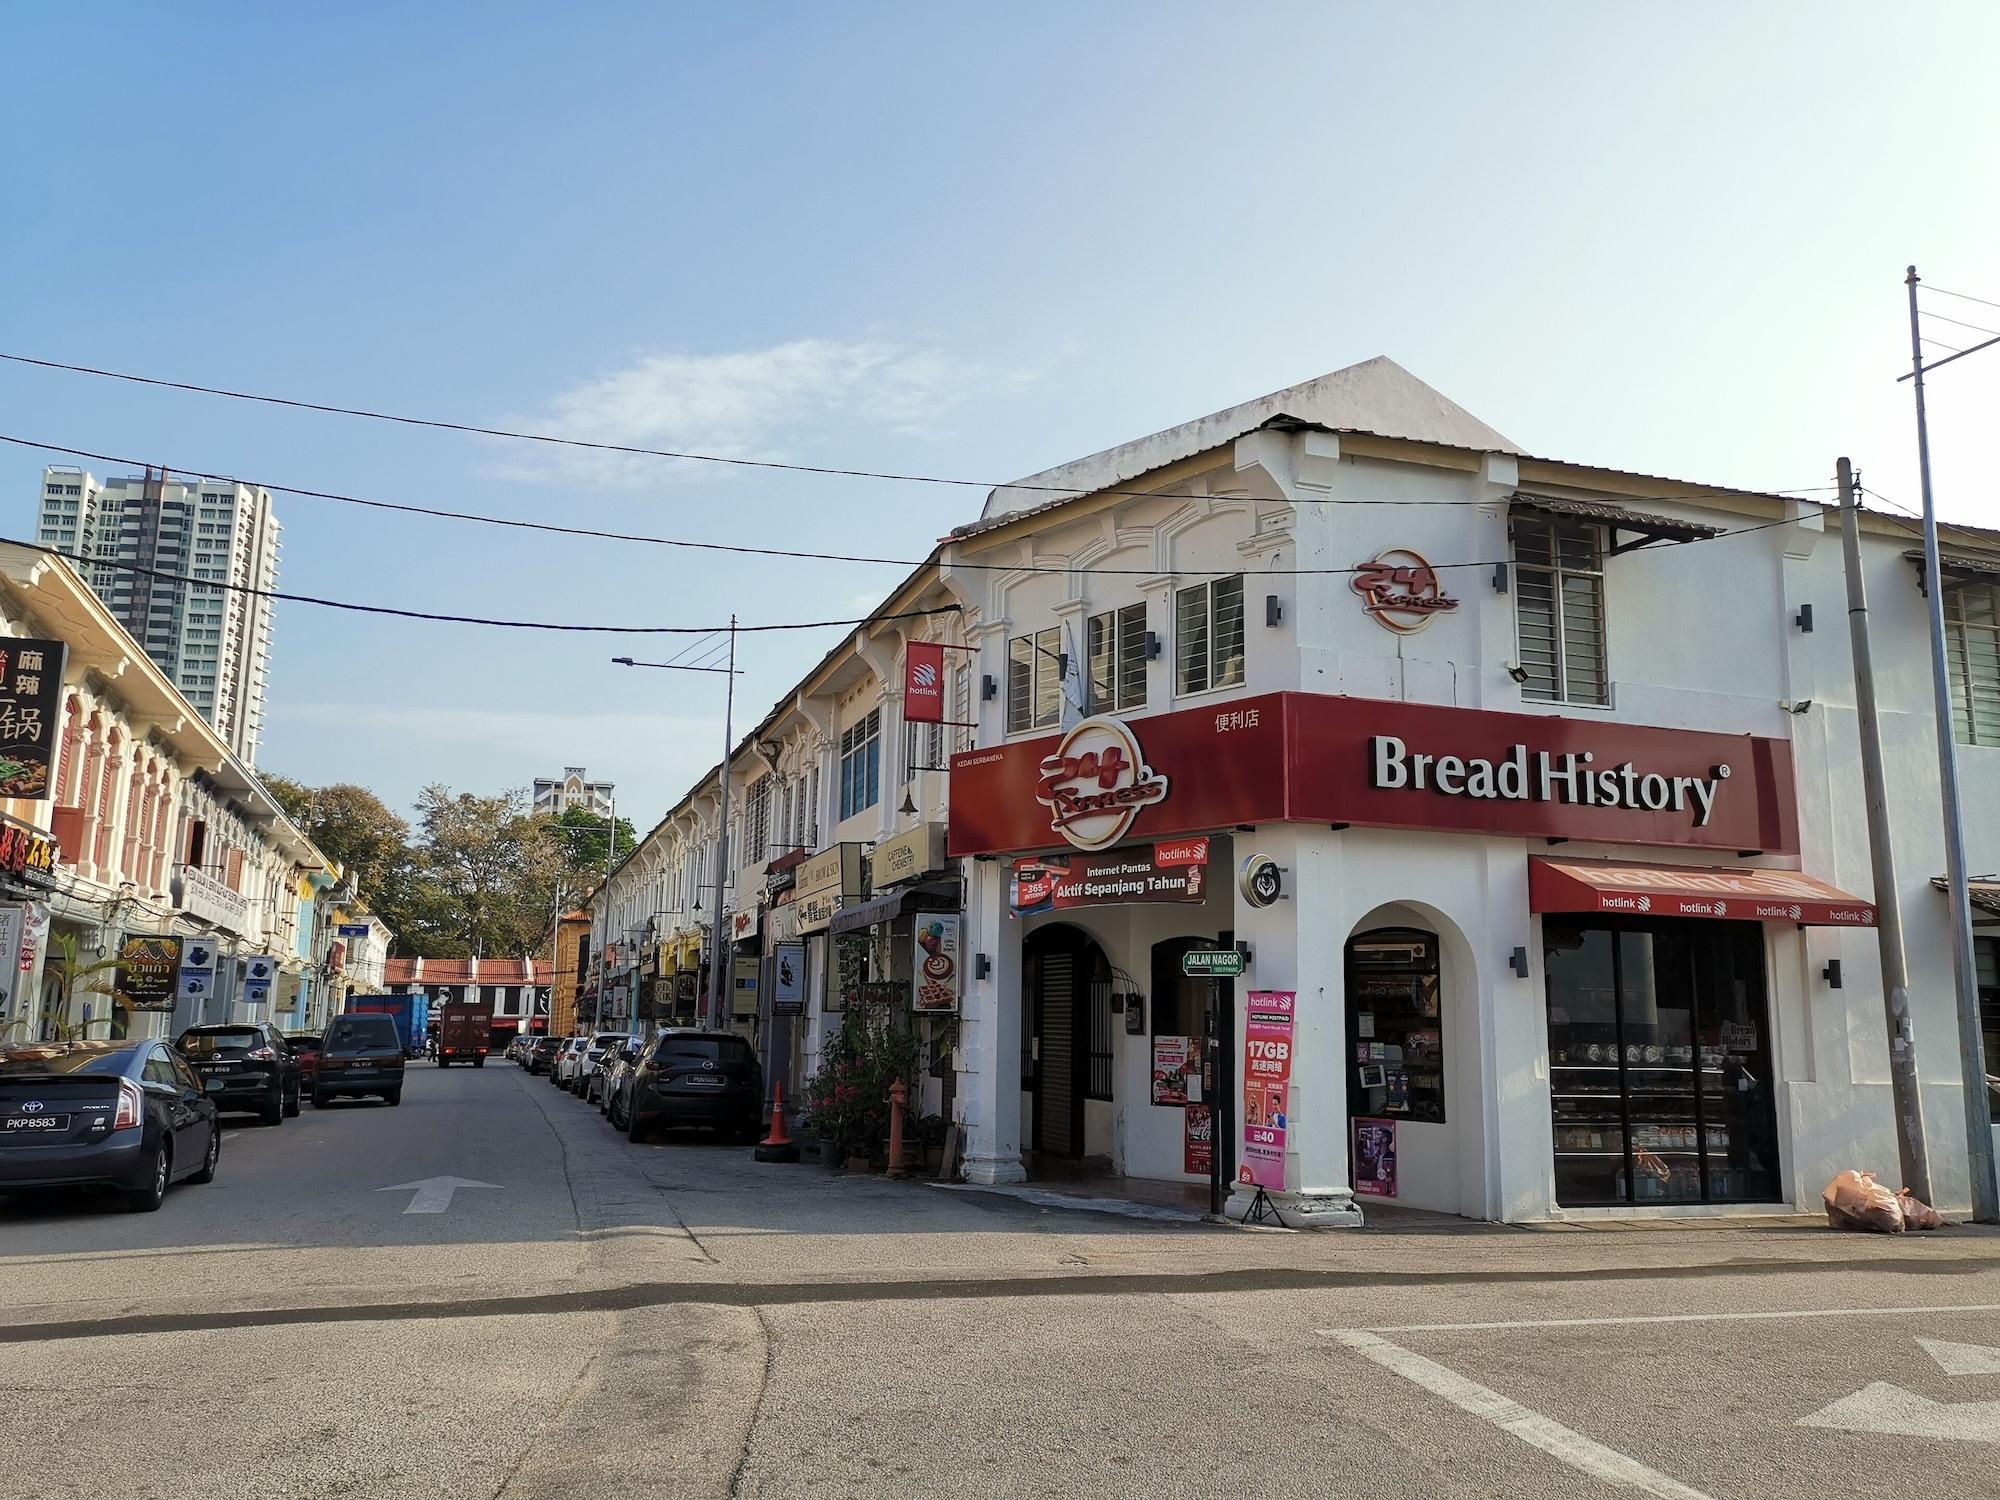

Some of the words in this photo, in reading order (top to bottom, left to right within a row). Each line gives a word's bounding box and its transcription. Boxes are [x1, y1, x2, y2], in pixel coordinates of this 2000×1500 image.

[15, 650, 44, 696] 麻辣
[909, 686, 938, 696] hotlink
[1214, 709, 1260, 733] 便利店
[1375, 735, 1529, 800] Bread
[1540, 751, 1718, 826] History
[1159, 847, 1191, 861] hotlink
[1087, 865, 1120, 878] Internet
[1121, 863, 1151, 874] Pantas
[1572, 866, 1761, 893] hotlink
[1056, 883, 1083, 898] Aktif
[1084, 879, 1145, 898] Sepanjang
[1147, 876, 1186, 890] Tahun
[1602, 897, 1636, 909] hotlink
[1680, 902, 1712, 914] hotlink
[1756, 906, 1788, 917] hotlink
[1829, 910, 1860, 922] hotlink
[1187, 954, 1211, 966] JALAN
[1212, 954, 1239, 966] NAGOR
[1250, 996, 1278, 1008] hotlink
[1731, 1022, 1756, 1035] Bread
[1248, 1040, 1289, 1060] 17GB
[1251, 1059, 1283, 1073] 高速网络
[6, 1117, 57, 1129] PKP8583
[1261, 1130, 1275, 1144] 40
